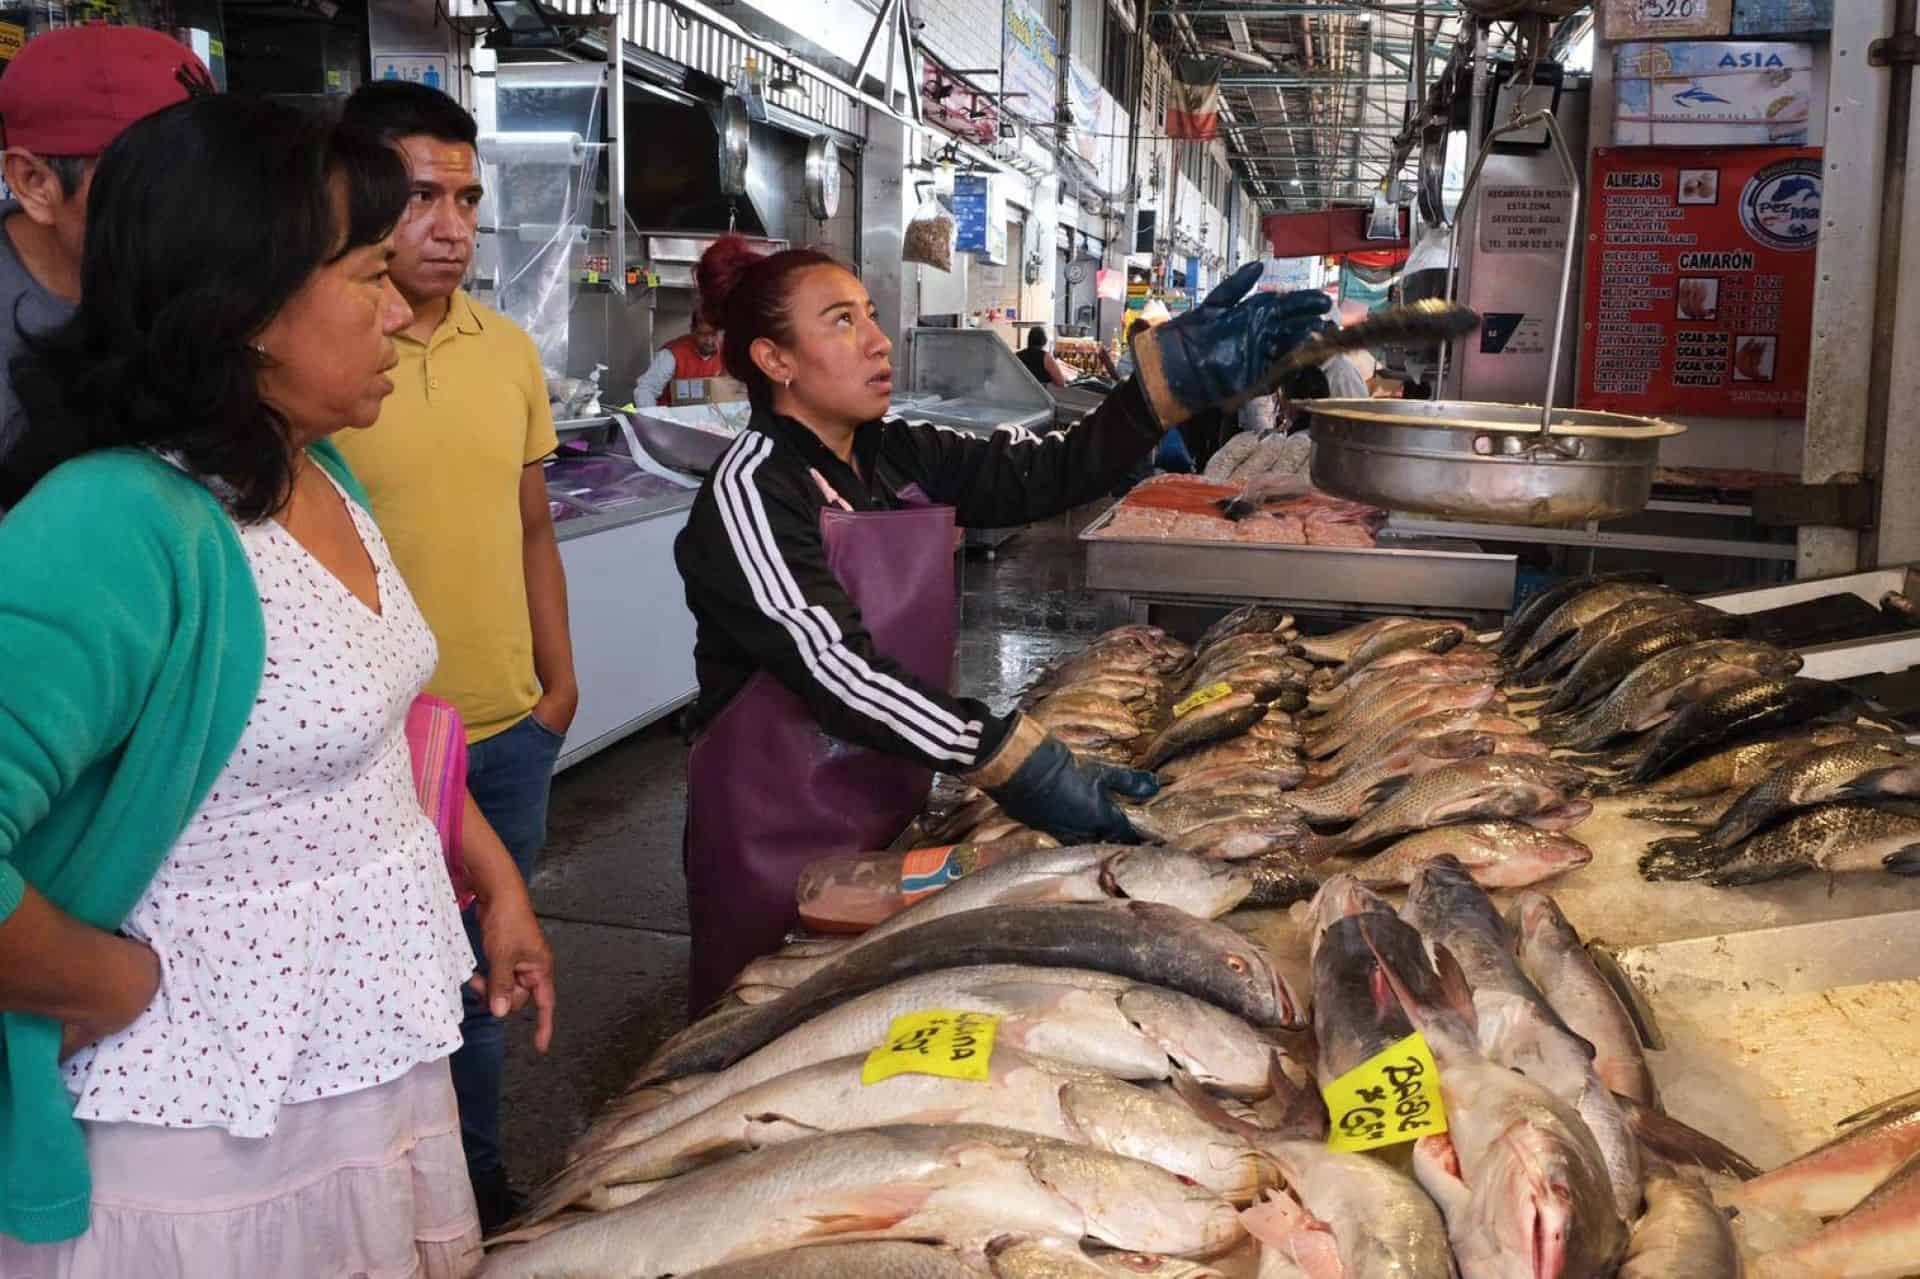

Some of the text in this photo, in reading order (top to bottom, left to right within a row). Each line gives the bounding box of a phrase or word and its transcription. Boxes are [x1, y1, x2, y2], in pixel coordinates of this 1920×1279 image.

[1718, 53, 1784, 68] ASIA
[1605, 172, 1661, 189] ALMEJAS
[1679, 249, 1753, 269] CAMARÓN
